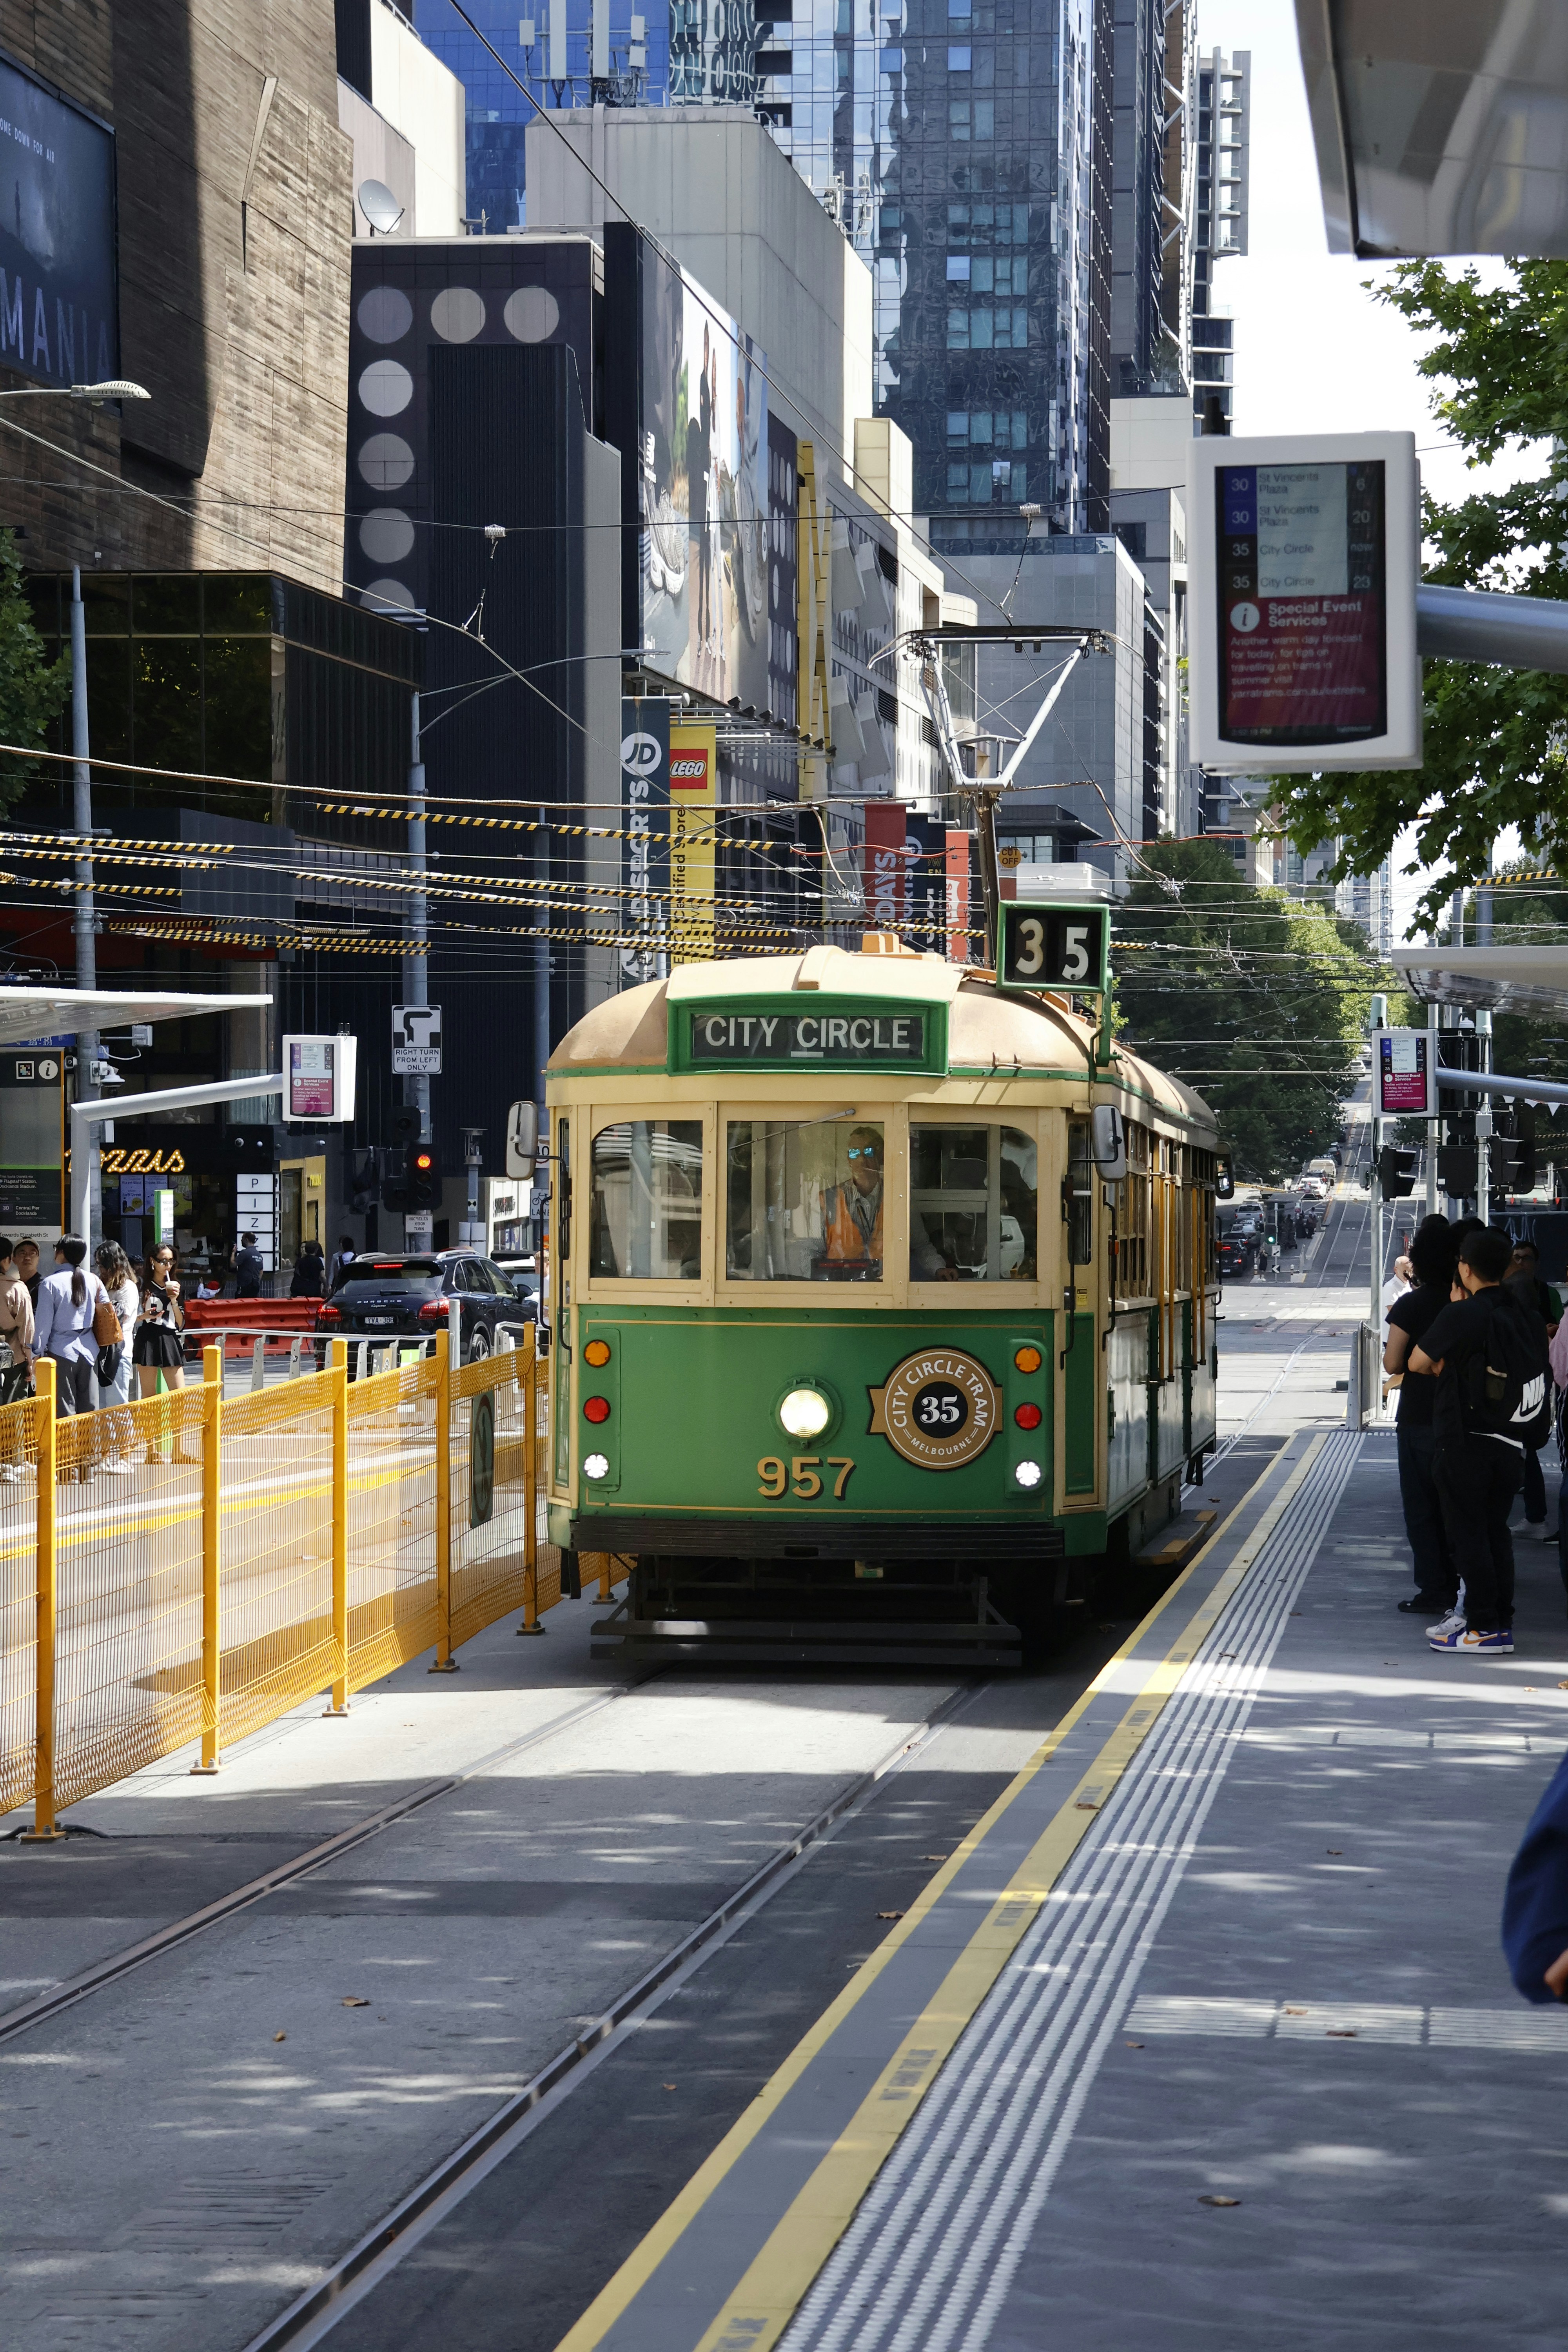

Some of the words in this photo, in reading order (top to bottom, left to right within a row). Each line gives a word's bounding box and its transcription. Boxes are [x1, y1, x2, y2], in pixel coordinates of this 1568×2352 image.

[15, 127, 30, 147] DOWN
[33, 140, 43, 156] FOR
[1232, 478, 1249, 491] 30
[1259, 473, 1270, 482] St
[1259, 485, 1288, 494] Plaza
[1232, 511, 1249, 524] 30
[1260, 506, 1270, 515] St
[1353, 510, 1370, 524] 20
[1260, 517, 1288, 526] Plaza
[1232, 543, 1249, 556] 35
[1260, 545, 1280, 556] City
[1284, 544, 1314, 554] Circle
[1233, 575, 1250, 588] 35
[1260, 577, 1280, 588] City
[1284, 577, 1315, 586] Circle
[1354, 576, 1370, 588] 23
[1269, 601, 1318, 617] Special
[1323, 600, 1362, 613] Event
[1269, 615, 1327, 627] Services
[625, 743, 656, 764] JD
[671, 761, 705, 777] LEGO
[674, 808, 685, 849] Sore
[673, 855, 685, 918] Cetified
[706, 1017, 779, 1047] CITY
[797, 1018, 910, 1049] CIRCLE
[893, 1386, 909, 1428] CITY
[906, 1359, 967, 1385] CIRCLE
[965, 1374, 989, 1428] TRAM
[920, 1395, 960, 1424] 35
[910, 1437, 971, 1455] MELBOURNE
[757, 1457, 855, 1497] 957
